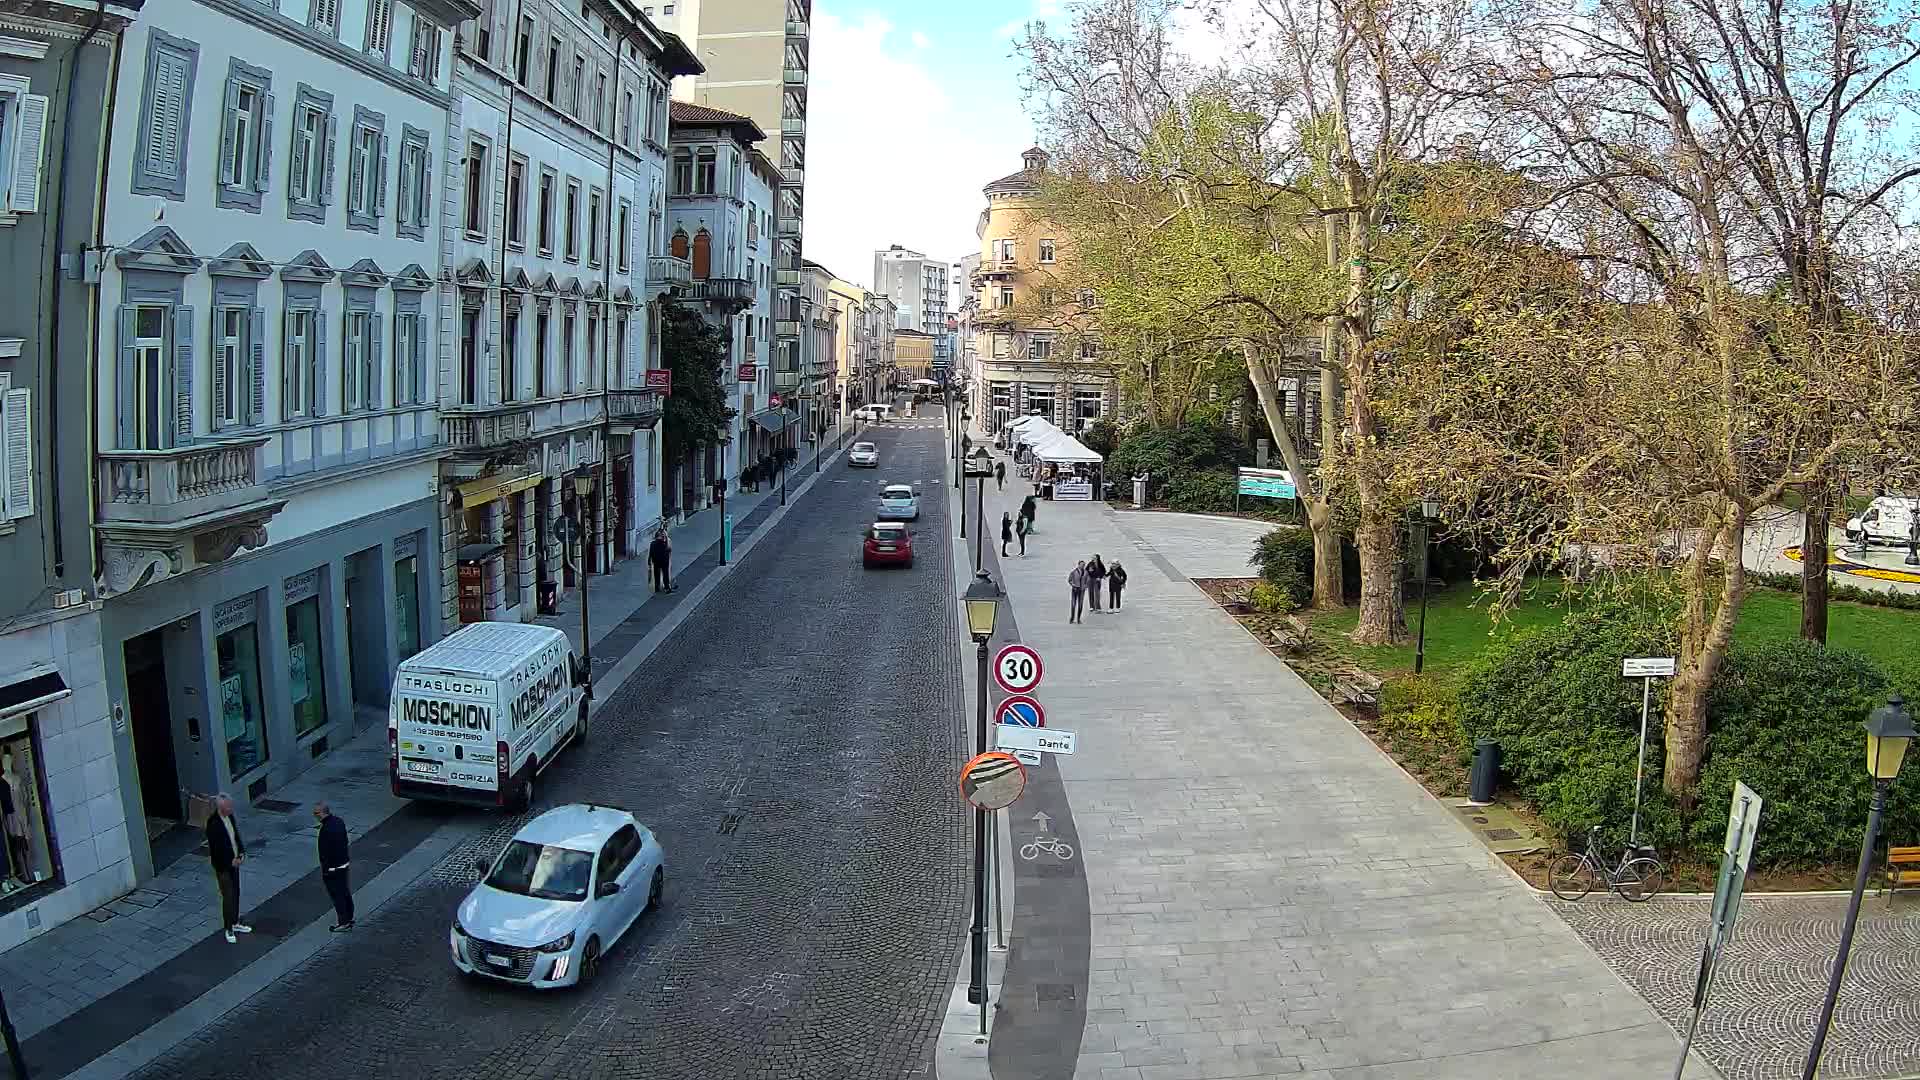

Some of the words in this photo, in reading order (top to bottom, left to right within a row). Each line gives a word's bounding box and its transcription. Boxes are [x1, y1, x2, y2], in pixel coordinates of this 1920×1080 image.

[510, 642, 562, 688] TRASLOCHI
[1005, 658, 1033, 681] 30
[405, 677, 489, 695] TRASLOCHI
[510, 660, 567, 731] MOSCHION
[403, 698, 491, 731] MOSCHION
[1038, 738, 1070, 750] Dante
[450, 772, 494, 784] GORIZIA
